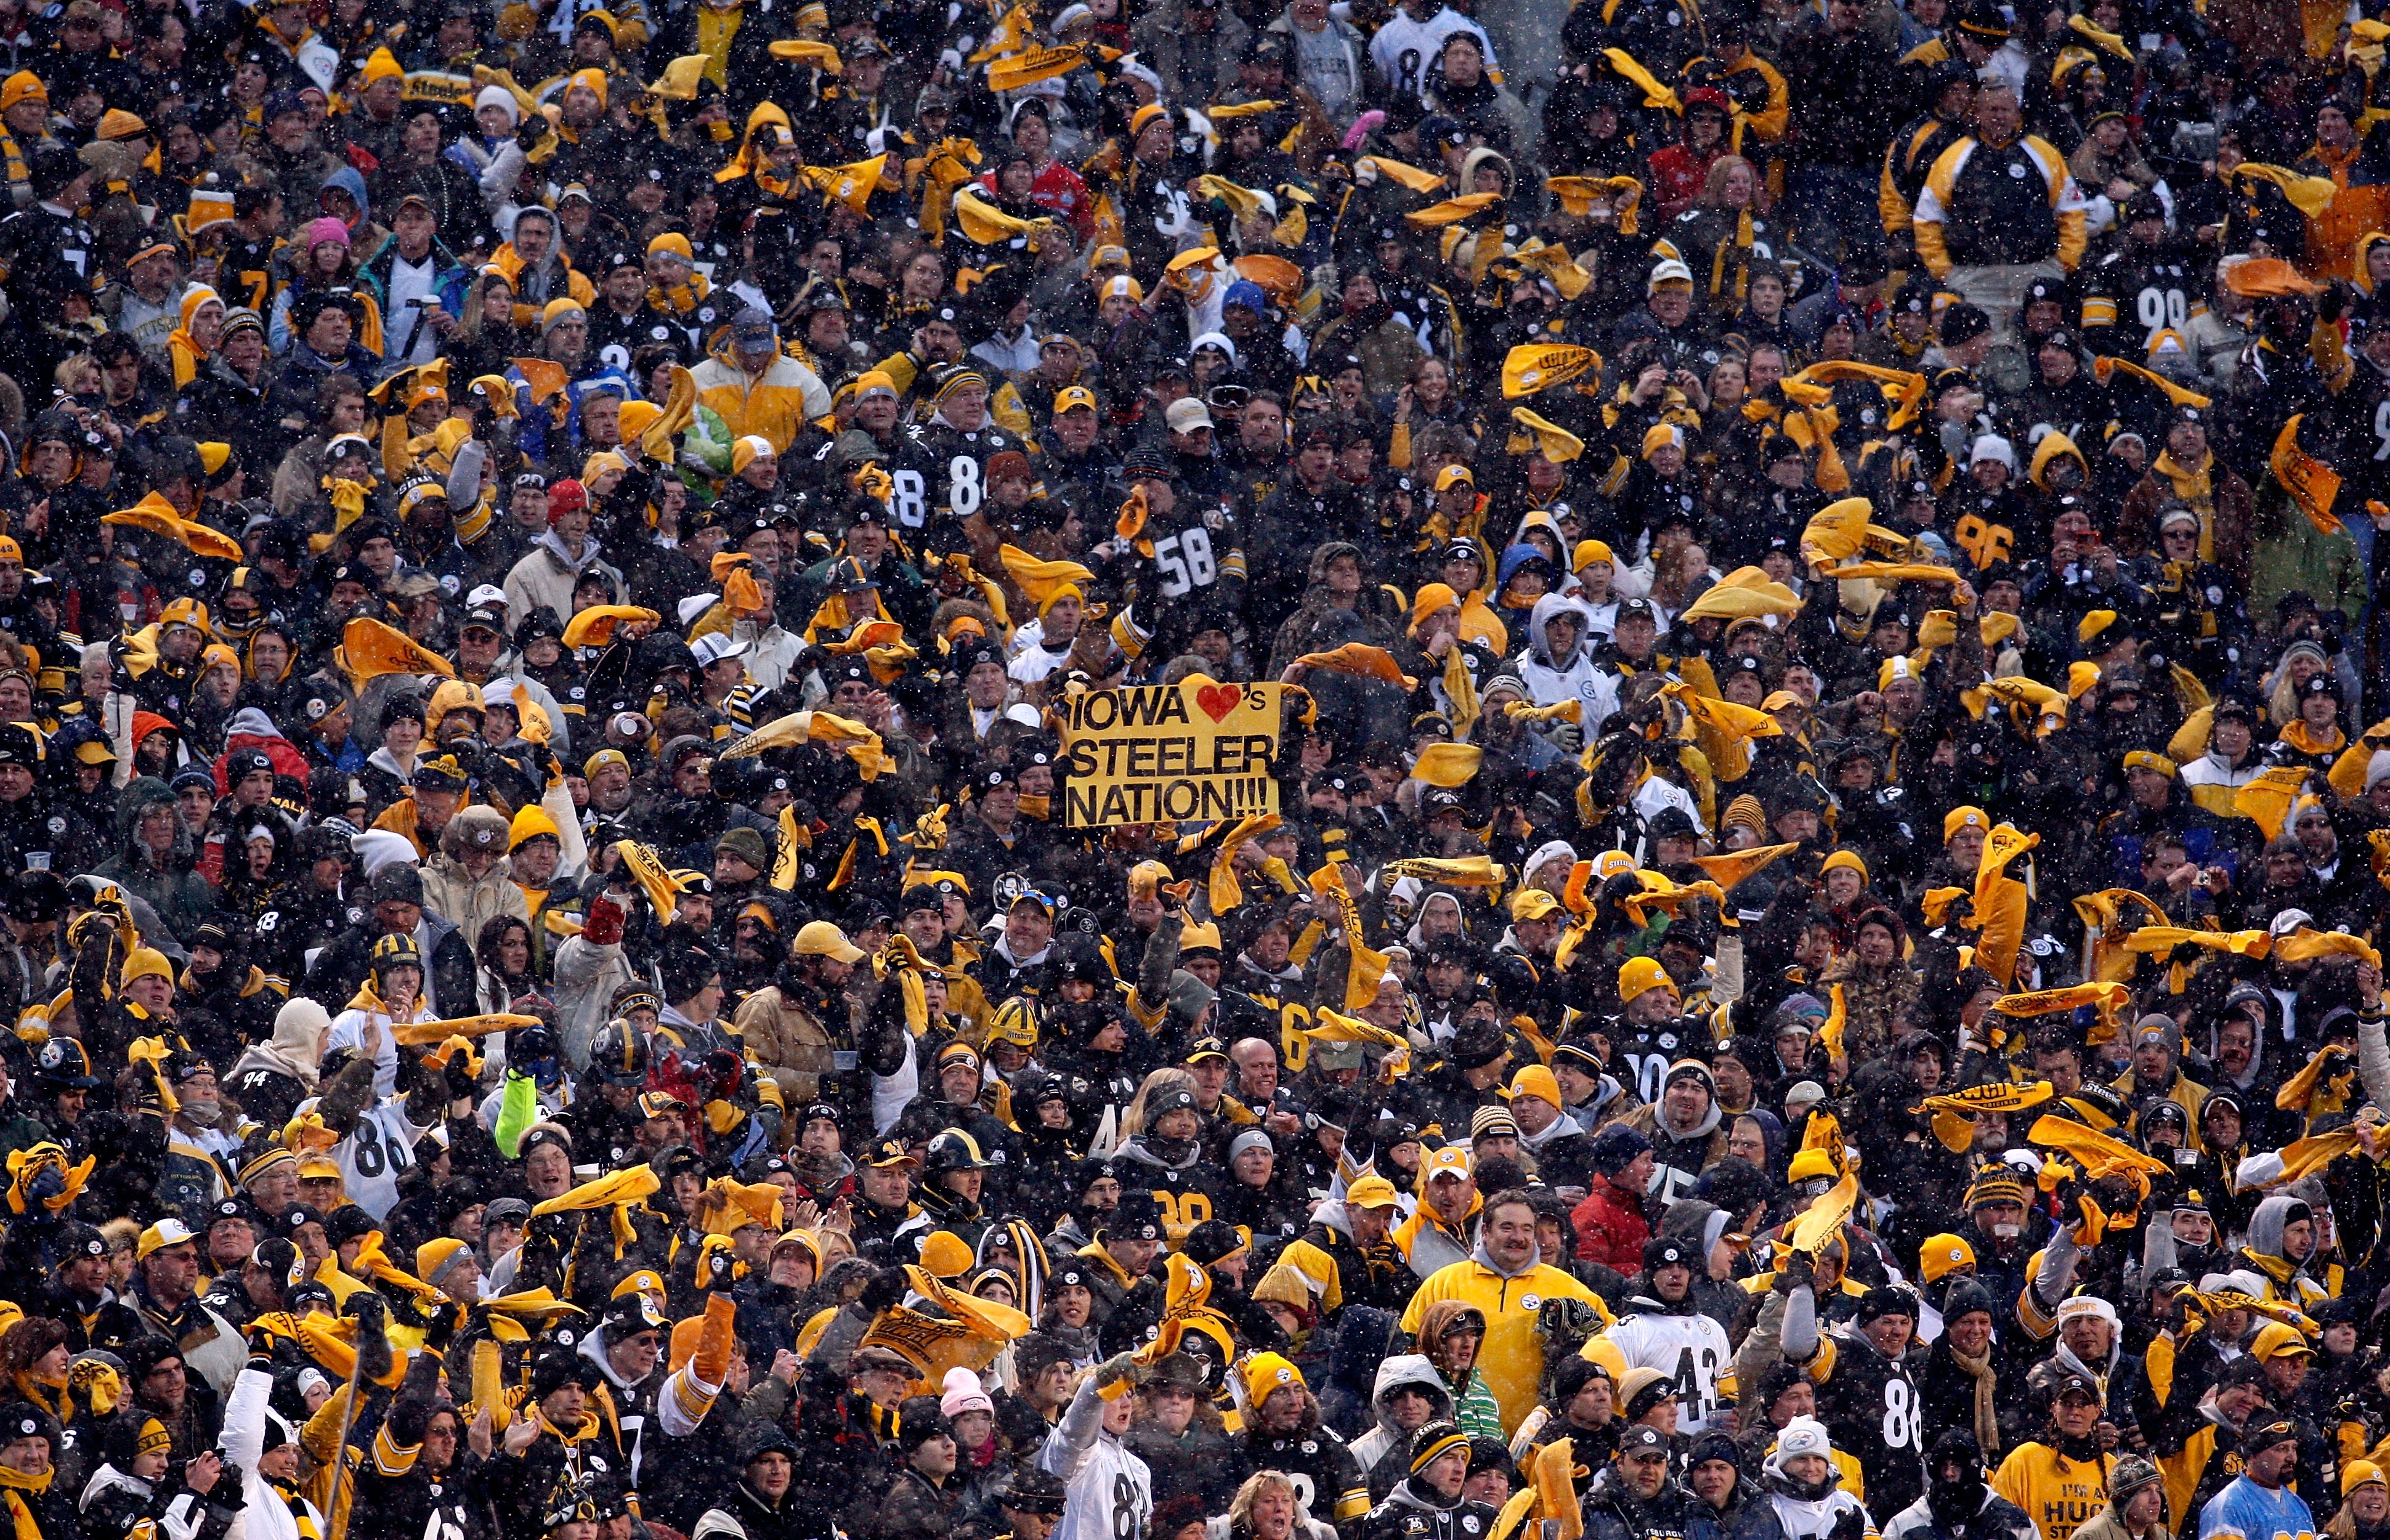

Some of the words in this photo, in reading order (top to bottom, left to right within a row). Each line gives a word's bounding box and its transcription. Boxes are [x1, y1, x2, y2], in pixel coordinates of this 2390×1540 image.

[548, 0, 603, 44] 4
[240, 271, 268, 311] 7
[881, 470, 925, 528] 8
[950, 455, 987, 516] 8
[1157, 527, 1216, 598] 58
[1072, 686, 1189, 731] IOWA
[1069, 734, 1274, 778] STEELER
[1067, 777, 1268, 827] NATION!!!
[243, 1071, 267, 1090] 94
[2086, 1082, 2121, 1105] Steelers
[1088, 1104, 1132, 1161] 4
[1674, 1347, 1718, 1422] 43
[619, 1416, 644, 1489] 7
[2062, 1483, 2088, 1497] I'M
[2094, 1488, 2104, 1501] A
[1634, 1528, 1685, 1539] PITTSBURGH
